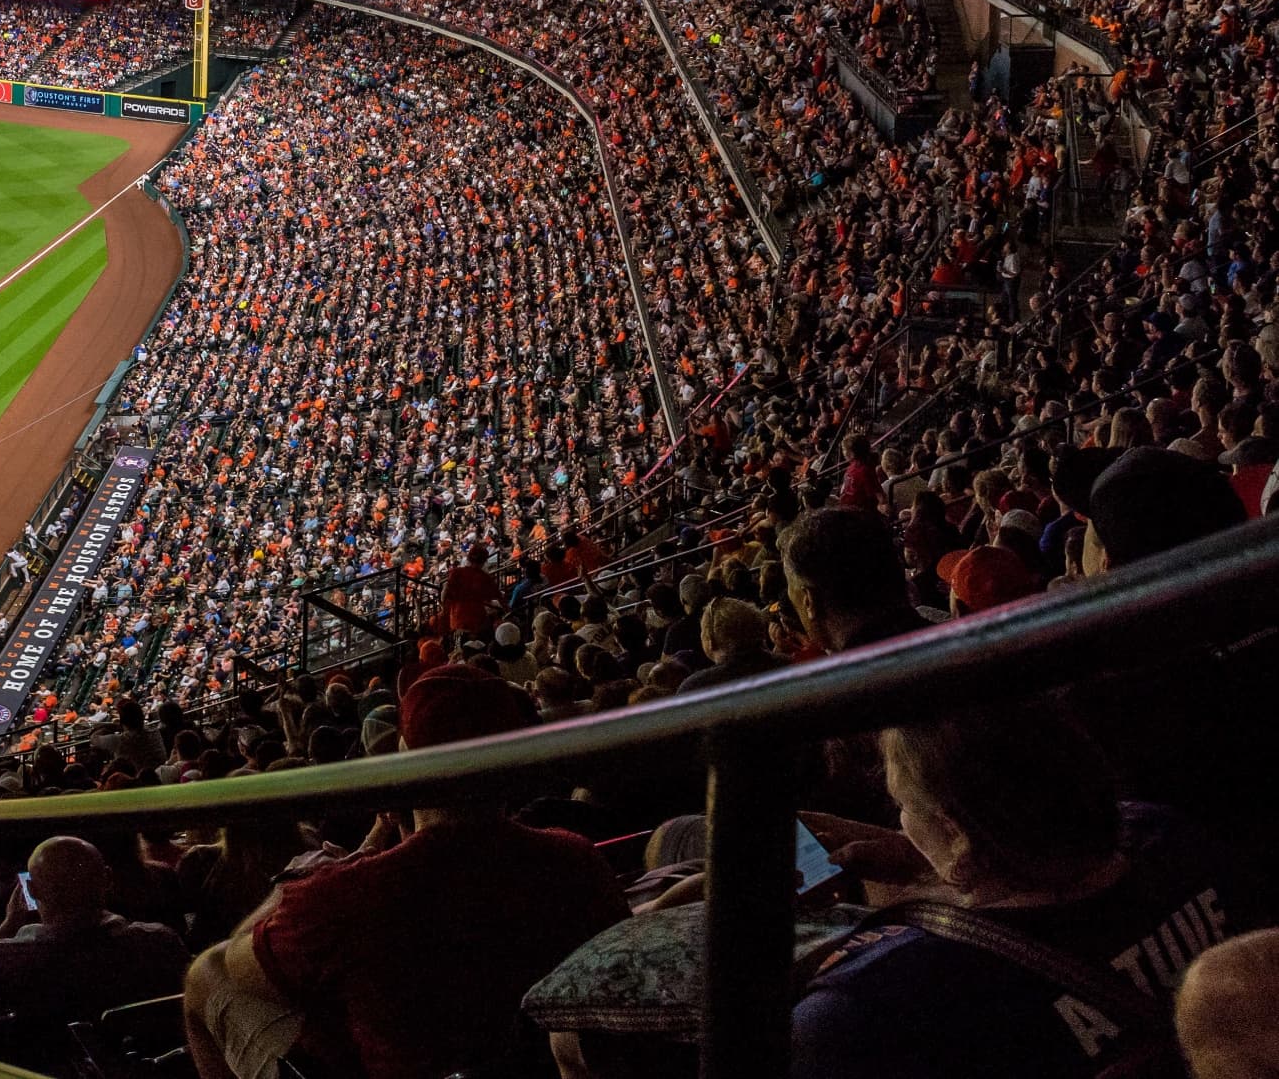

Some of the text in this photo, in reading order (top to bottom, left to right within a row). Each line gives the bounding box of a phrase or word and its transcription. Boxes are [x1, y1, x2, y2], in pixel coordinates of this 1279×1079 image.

[79, 95, 101, 105] FIRST
[123, 102, 186, 118] POWERADE
[1, 476, 136, 693] HOME OF THE HOUSTON ASTROS
[1053, 887, 1227, 1057] ATUVE
